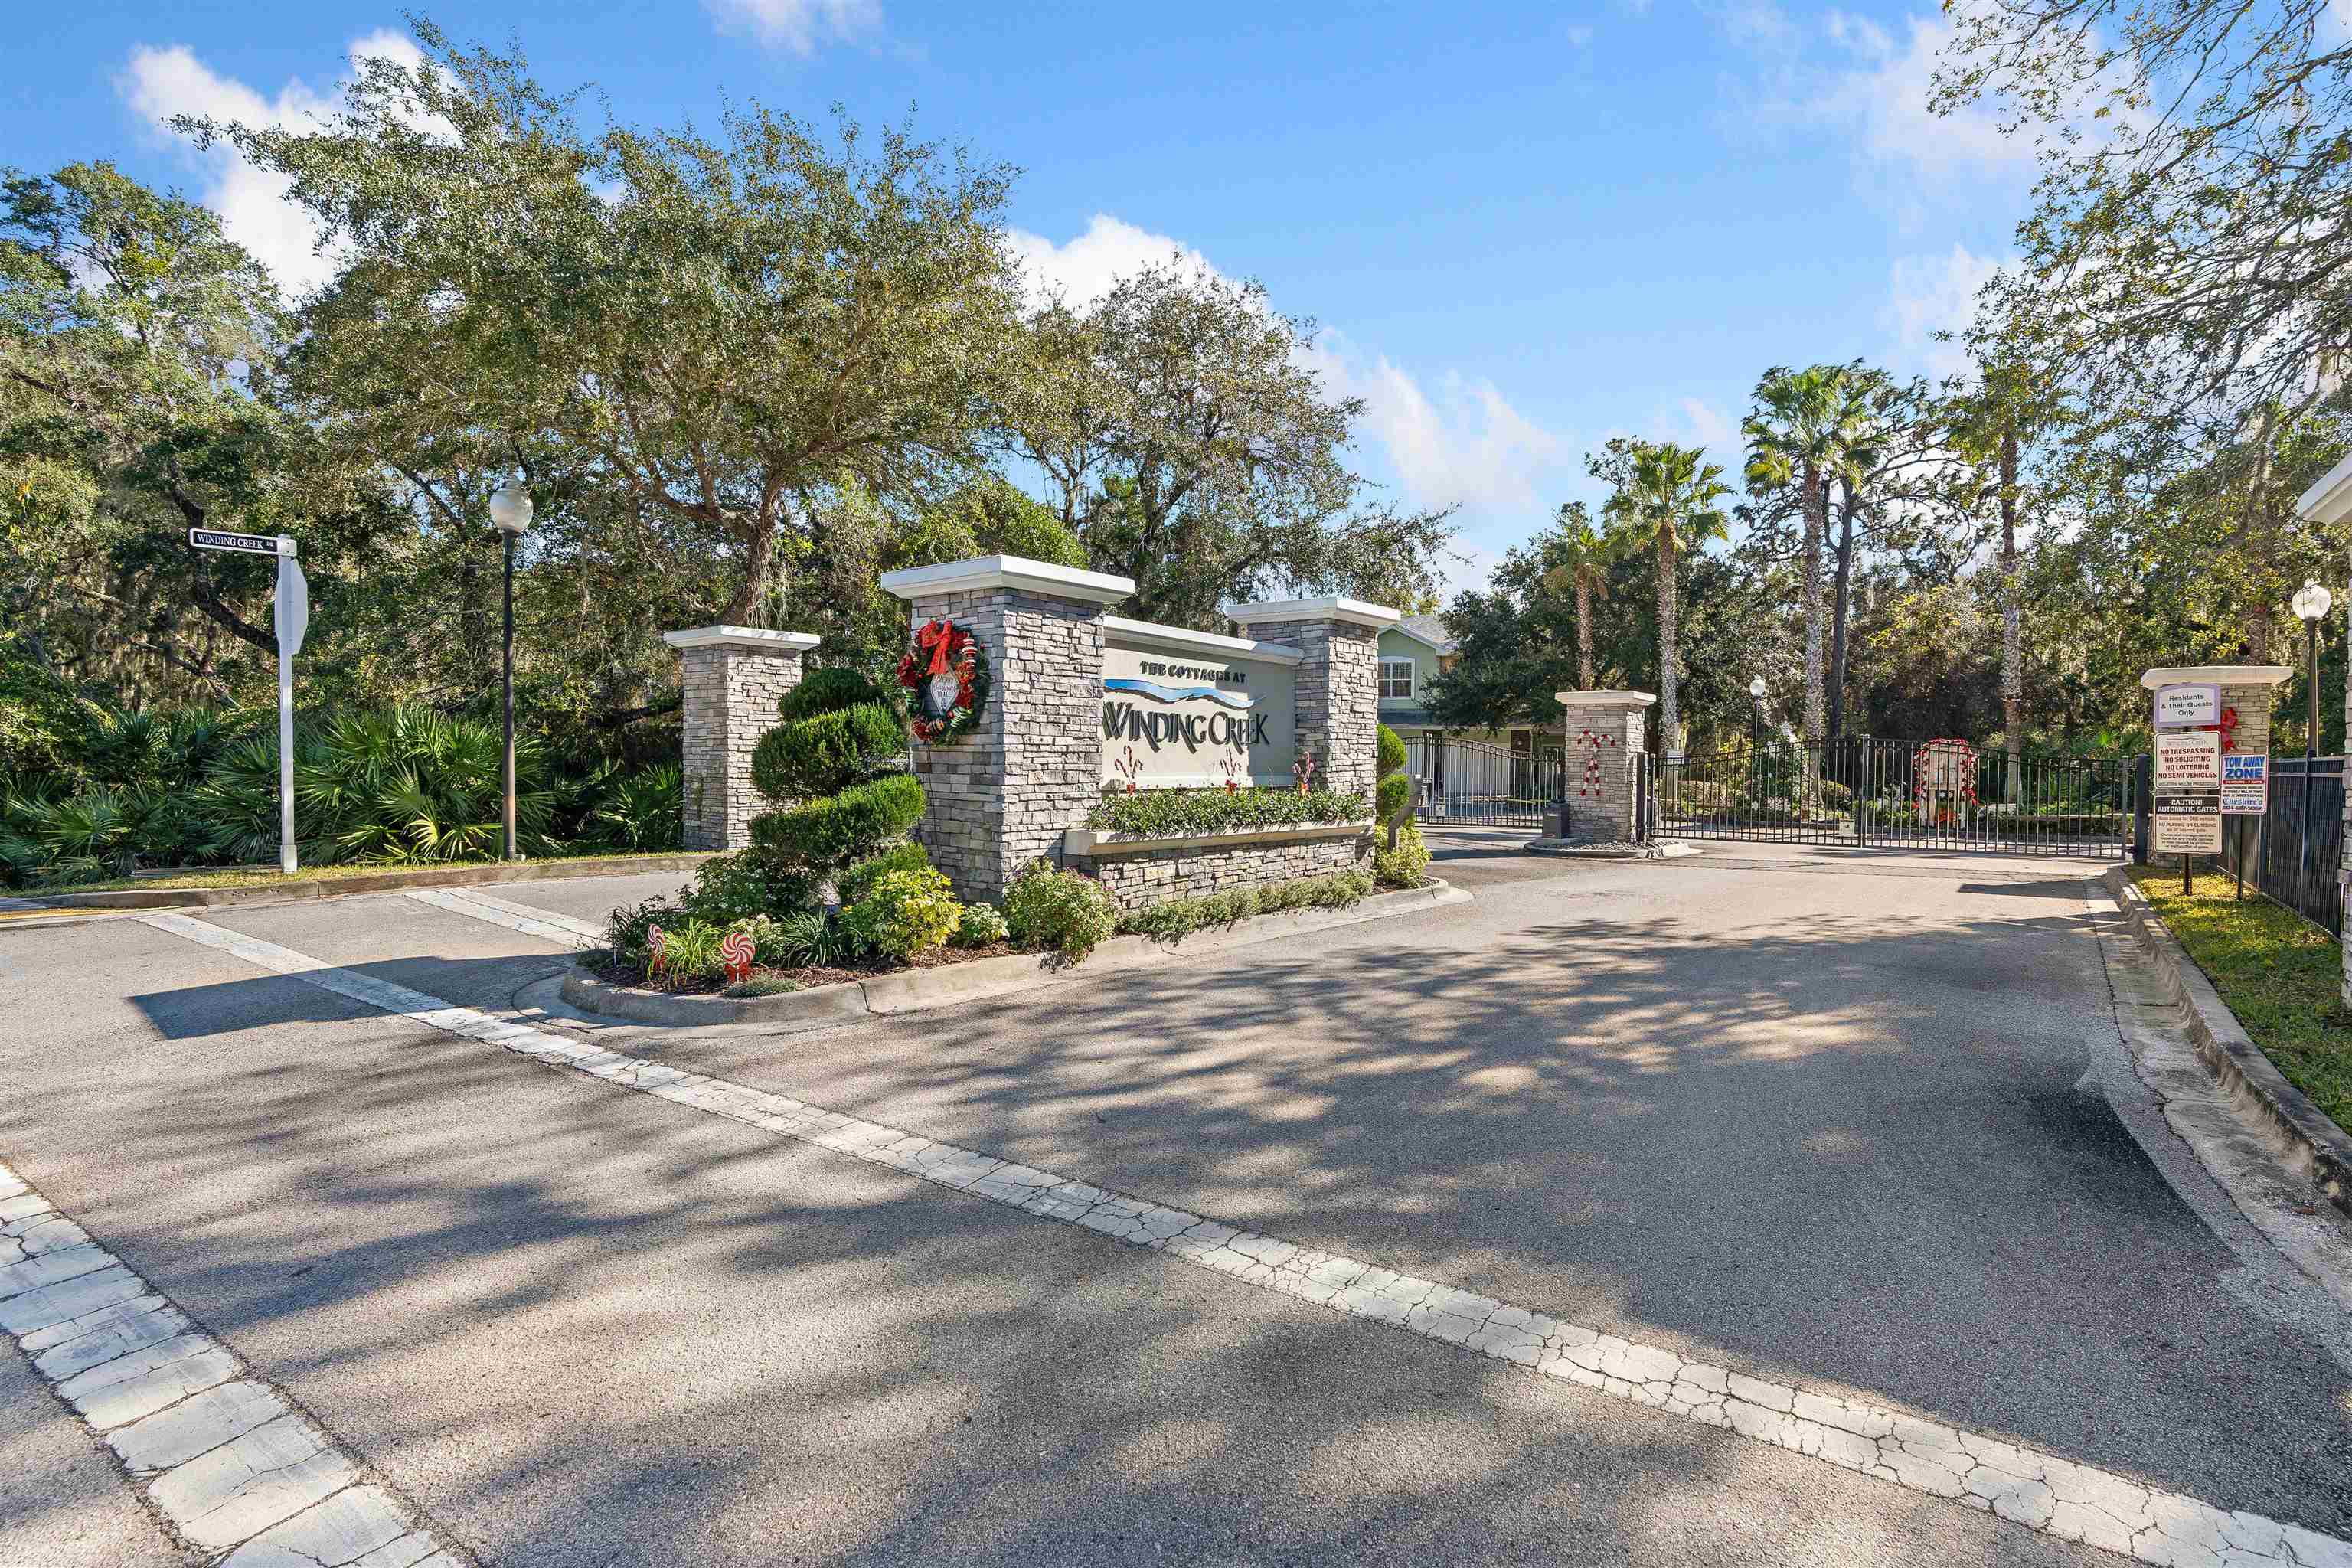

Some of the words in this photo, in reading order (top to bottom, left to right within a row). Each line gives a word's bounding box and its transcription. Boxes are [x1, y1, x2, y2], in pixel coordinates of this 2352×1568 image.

[197, 534, 236, 547] WINDING
[237, 538, 263, 549] CREEK
[1139, 661, 1167, 675] THE
[1168, 665, 1230, 682] COTTAGES
[1233, 672, 1246, 683] AT
[1102, 701, 1207, 754] WINDING
[1207, 711, 1270, 756] CREEK
[2224, 756, 2243, 767] TOW
[2243, 756, 2265, 767] AWAY
[2225, 768, 2263, 779] ZONE
